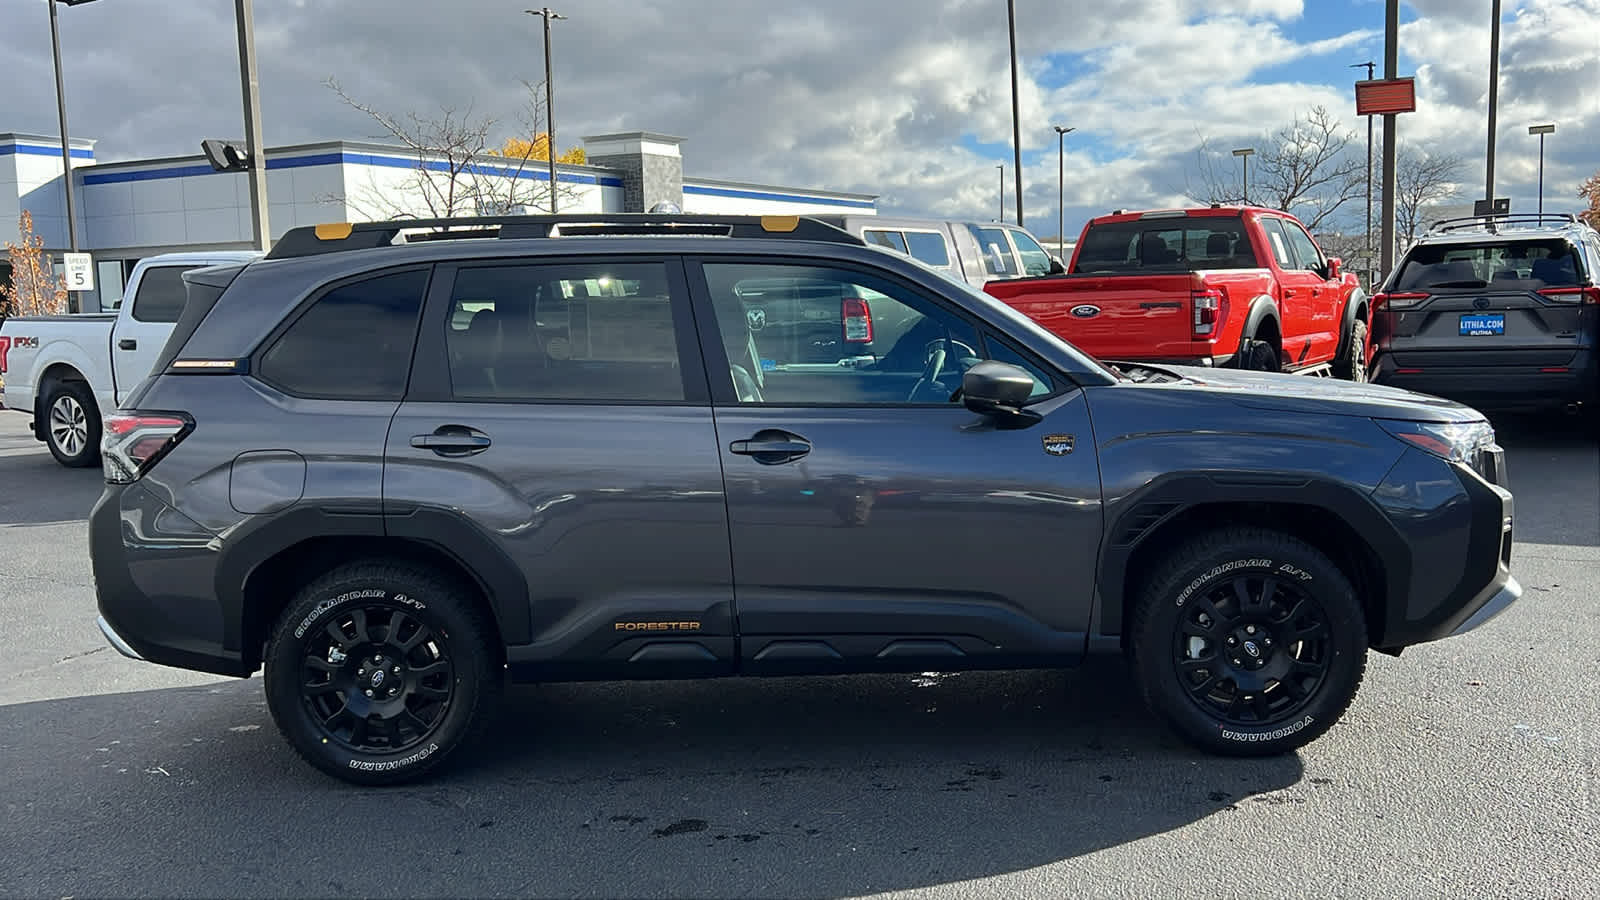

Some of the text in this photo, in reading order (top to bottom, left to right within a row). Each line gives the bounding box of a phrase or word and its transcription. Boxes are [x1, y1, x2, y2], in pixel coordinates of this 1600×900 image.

[75, 273, 85, 285] 5
[1460, 320, 1504, 329] LITHIA.COM
[13, 337, 39, 348] FX4
[1175, 559, 1313, 607] GEOLANDAR A/T
[294, 589, 426, 639] GEOLANDAR A/T
[615, 621, 701, 631] FORESTER
[1222, 715, 1314, 742] YOKOHAMA
[349, 743, 439, 771] YOKOHAMA
